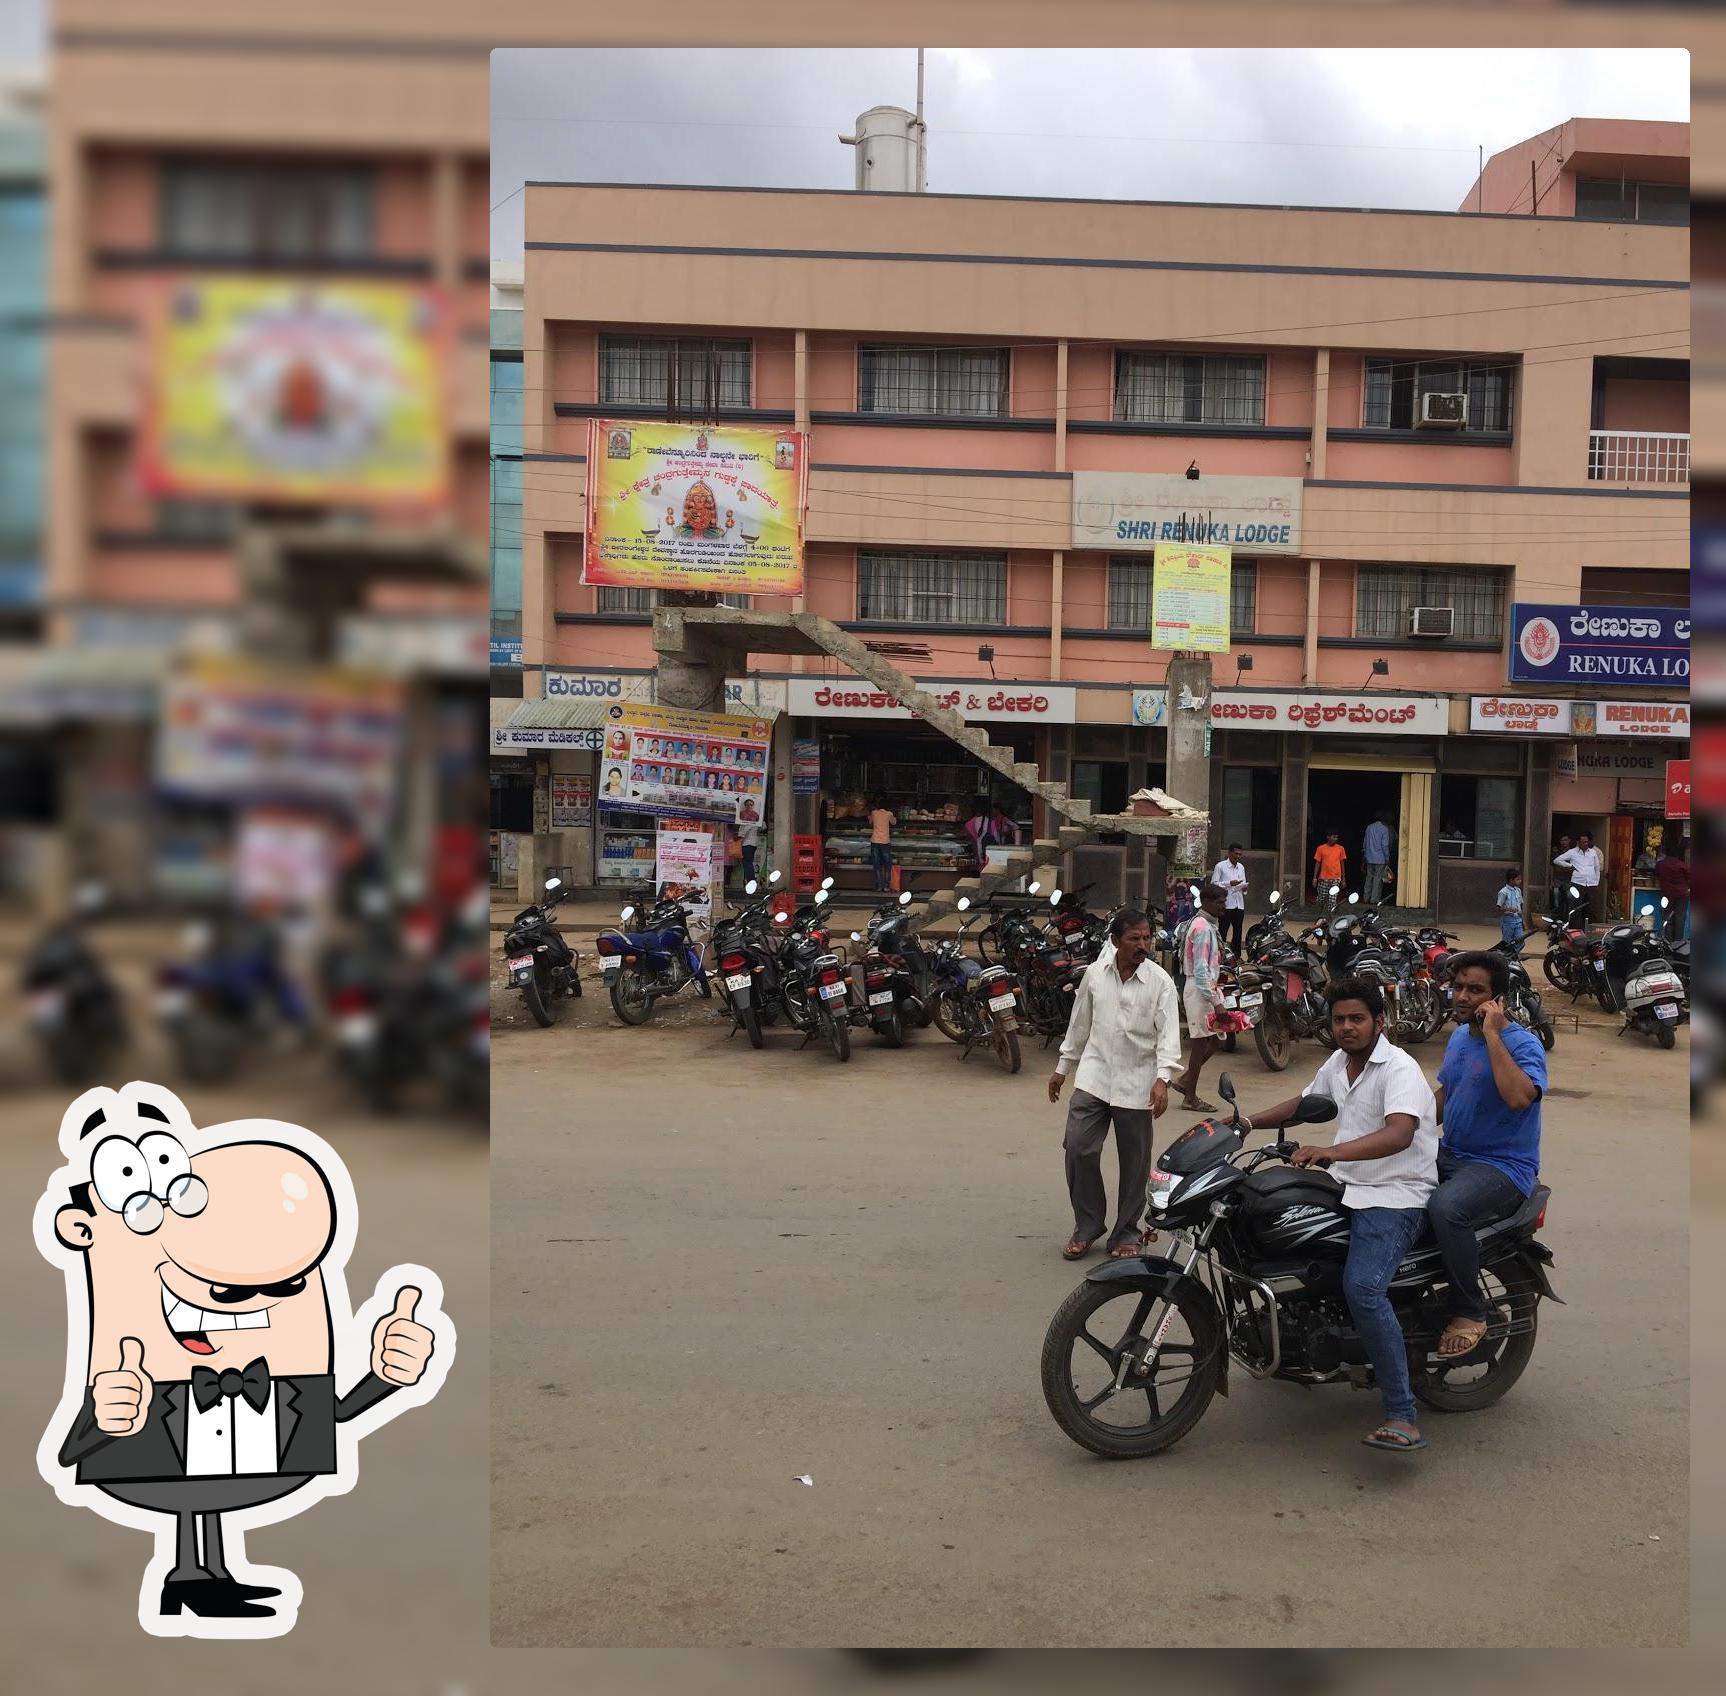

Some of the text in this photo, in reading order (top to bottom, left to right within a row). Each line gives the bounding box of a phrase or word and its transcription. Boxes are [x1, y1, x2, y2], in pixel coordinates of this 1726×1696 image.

[1116, 520, 1291, 544] SHRI RENUKA LODGE
[1569, 609, 1662, 639] ರೇಣುಕಾ
[1568, 654, 1690, 677] RENUKA LO
[548, 675, 622, 697] ಕುಮಾರ
[966, 694, 982, 711] &
[987, 691, 1049, 713] ಬೇಕರಿ
[1480, 697, 1559, 720] ರೇಣುಕಾ
[1605, 705, 1689, 724] RENUKA
[496, 729, 508, 745] ಶ್ರೀ
[511, 730, 544, 742] ಕುಮಾರ
[1619, 724, 1671, 734] LODGE
[1614, 756, 1654, 770] LODGE
